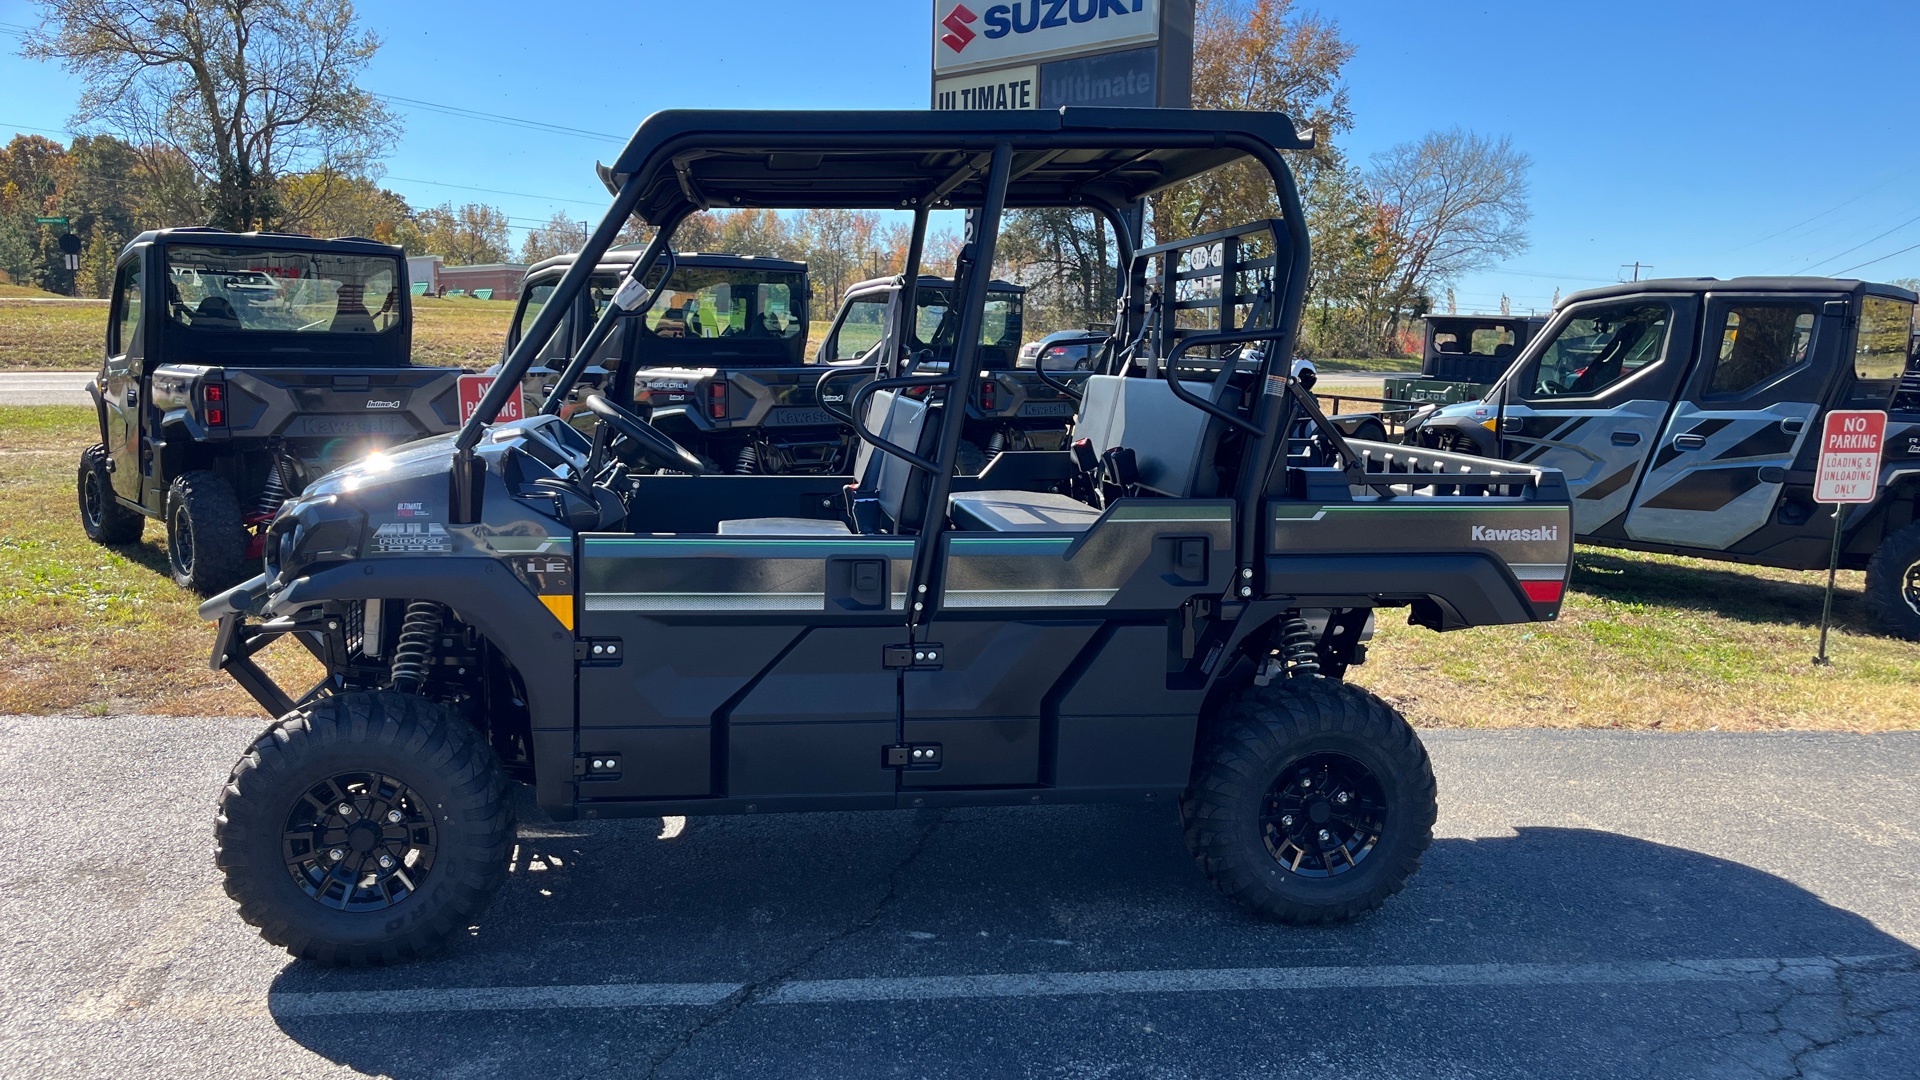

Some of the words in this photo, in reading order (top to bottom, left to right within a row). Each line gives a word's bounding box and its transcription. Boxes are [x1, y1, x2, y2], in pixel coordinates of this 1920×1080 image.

[1051, 69, 1150, 105] Ultimate
[1192, 251, 1206, 265] 676
[1213, 249, 1222, 262] 67
[478, 382, 491, 399] N
[1411, 392, 1448, 401] ROXOR
[1025, 404, 1066, 415] Kawasaki
[777, 410, 835, 425] Kawasa
[303, 417, 399, 434] Kawasaki
[1843, 418, 1867, 432] NO
[1829, 434, 1877, 449] PARKING
[1827, 458, 1863, 468] LOADING
[1865, 458, 1872, 467] &
[1824, 471, 1871, 481] UNLOADING
[1834, 484, 1857, 494] ONLY
[397, 502, 423, 510] ULTIMATE
[372, 523, 450, 538] MULE
[1471, 526, 1558, 541] Kawasaki
[527, 562, 566, 573] LE
